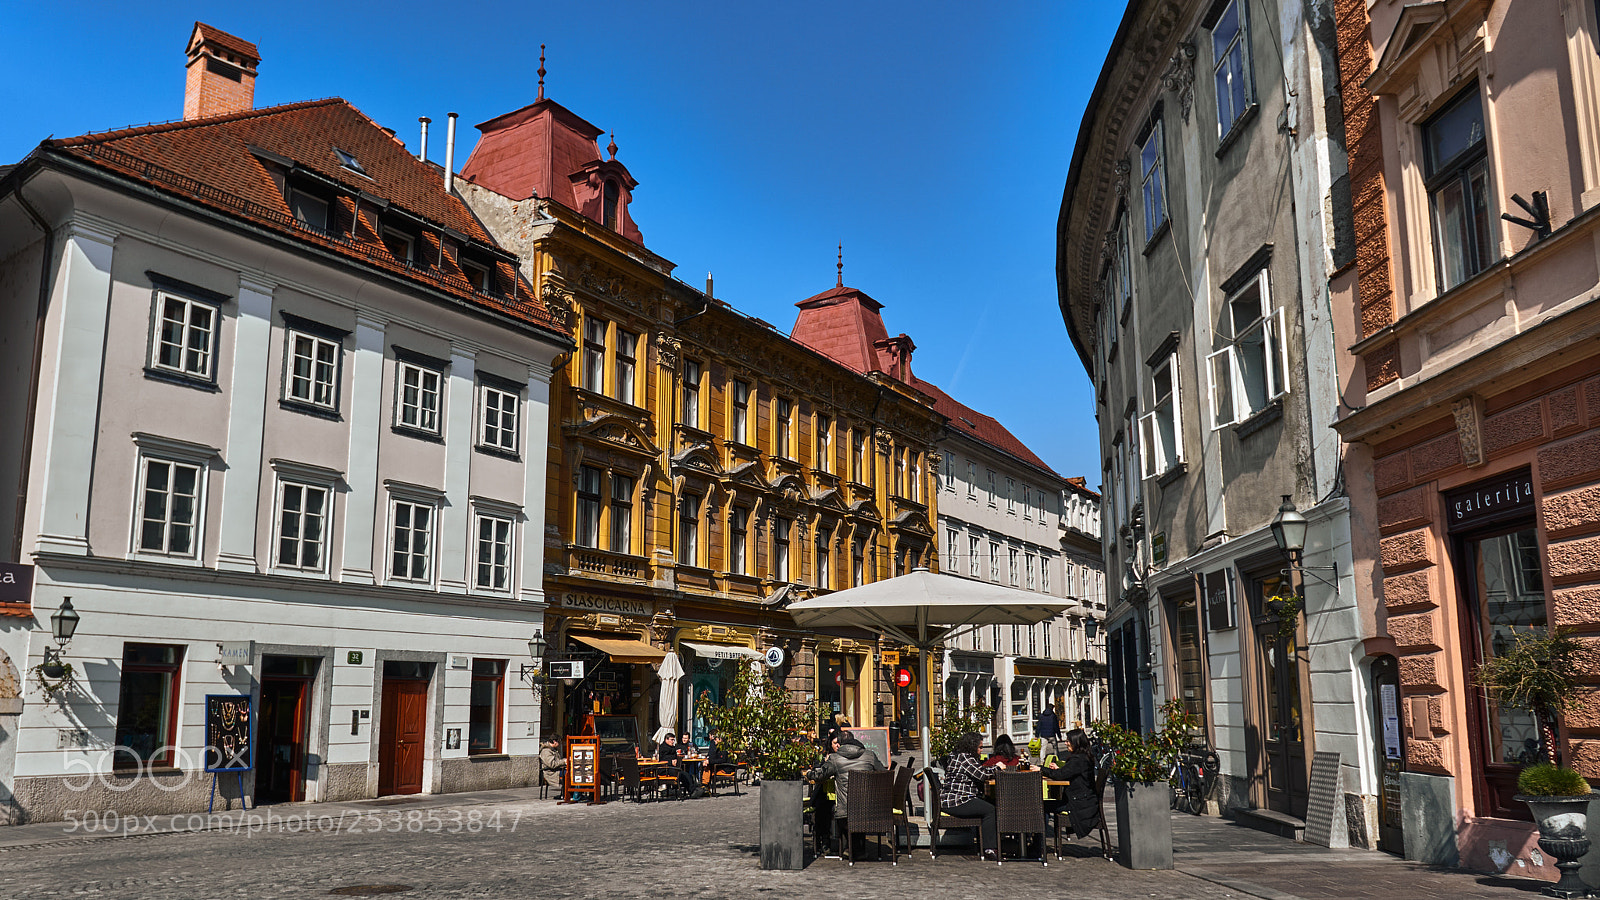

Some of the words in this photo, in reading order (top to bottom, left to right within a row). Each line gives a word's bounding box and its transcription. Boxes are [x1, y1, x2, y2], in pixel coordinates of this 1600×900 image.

[1455, 481, 1532, 519] galerija
[0, 571, 16, 584] a
[222, 648, 249, 657] KAMEN
[714, 651, 728, 659] PETIT
